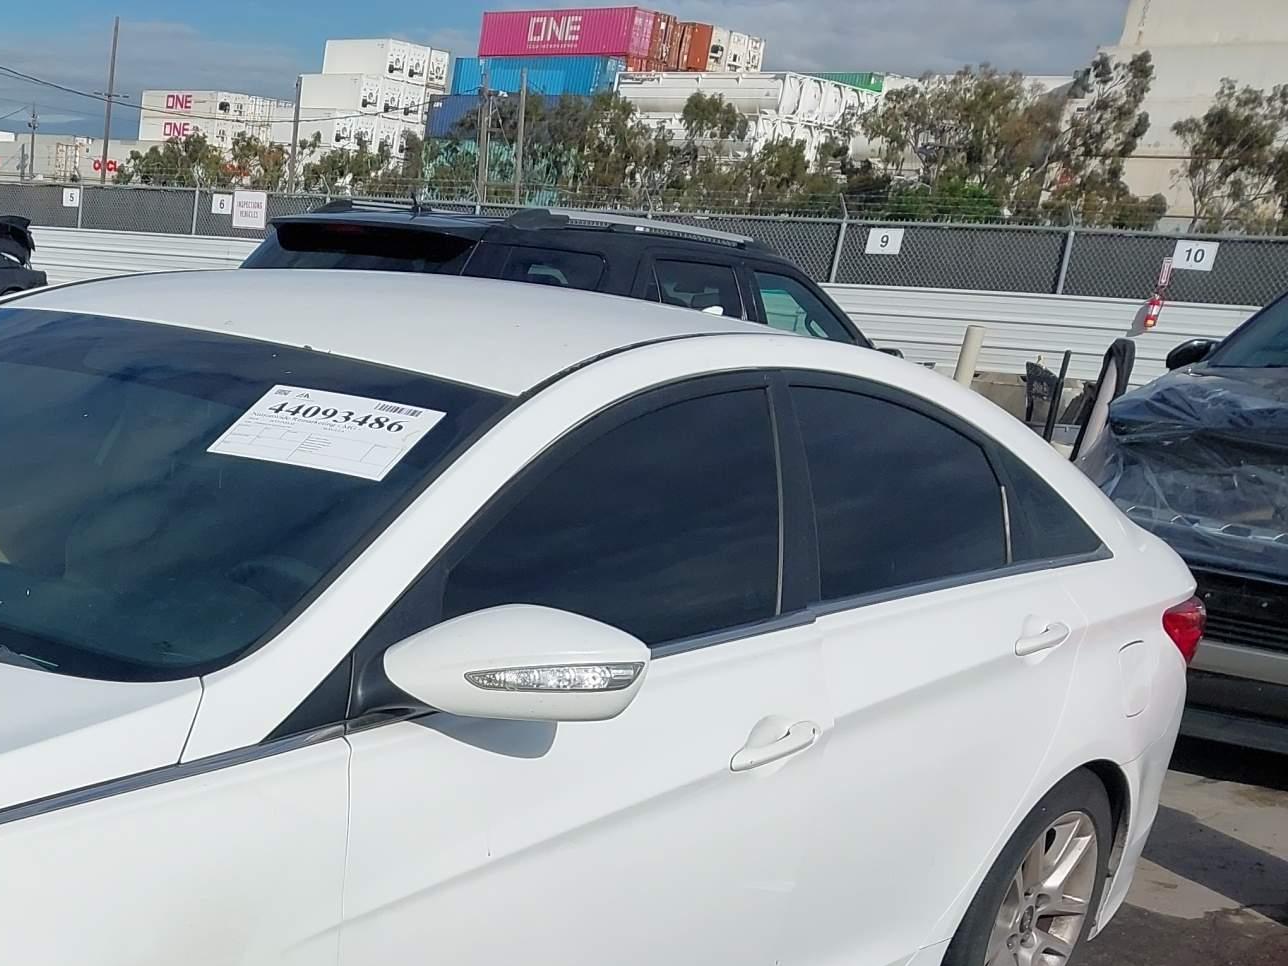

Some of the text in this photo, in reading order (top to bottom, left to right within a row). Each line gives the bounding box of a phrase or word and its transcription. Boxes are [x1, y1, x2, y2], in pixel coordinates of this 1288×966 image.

[528, 16, 582, 42] ONE
[166, 94, 192, 109] ONE
[163, 122, 190, 137] ONE
[93, 160, 118, 172] OCL
[69, 193, 75, 202] 5
[219, 199, 225, 209] 6
[880, 234, 889, 248] 9
[1185, 248, 1205, 263] 10
[268, 401, 409, 433] 44093486
